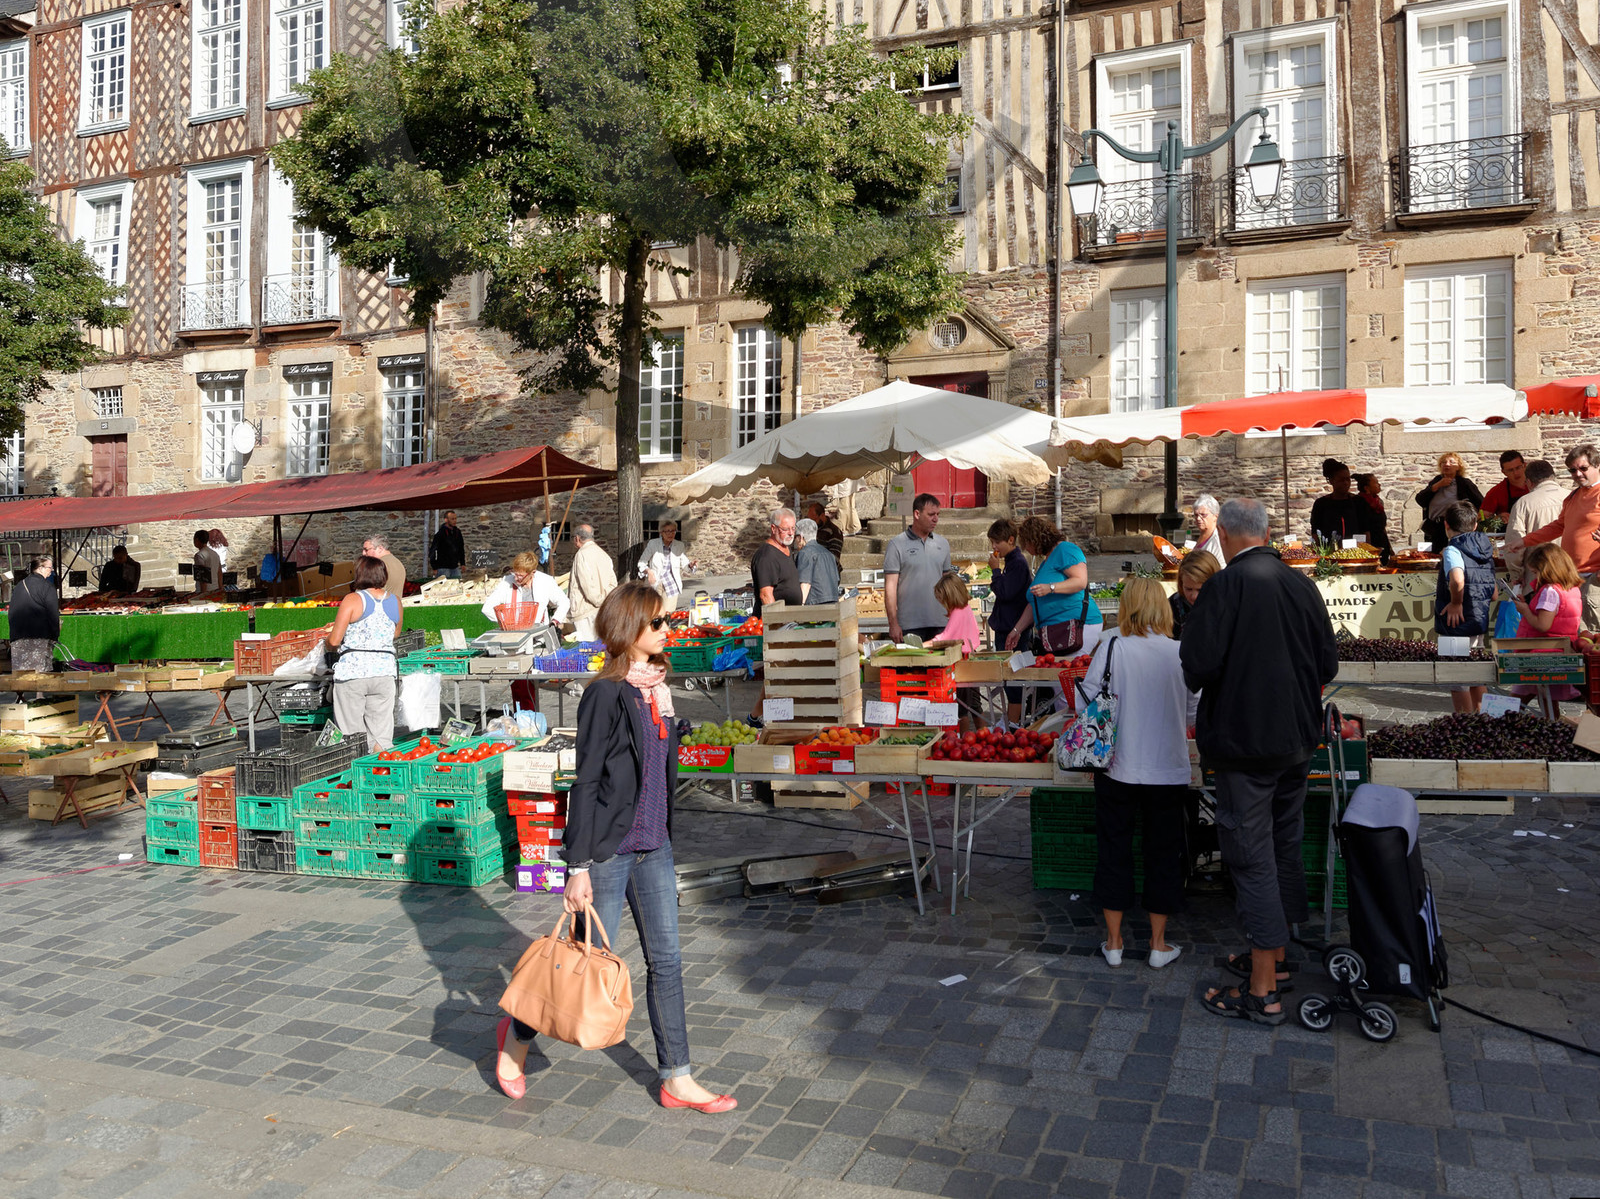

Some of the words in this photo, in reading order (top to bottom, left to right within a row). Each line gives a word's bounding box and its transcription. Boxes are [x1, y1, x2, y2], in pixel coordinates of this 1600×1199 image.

[1036, 379, 1047, 388] 26
[1350, 583, 1393, 592] OLIVES
[1326, 597, 1376, 606] LIVADES
[1330, 612, 1357, 620] ASTI
